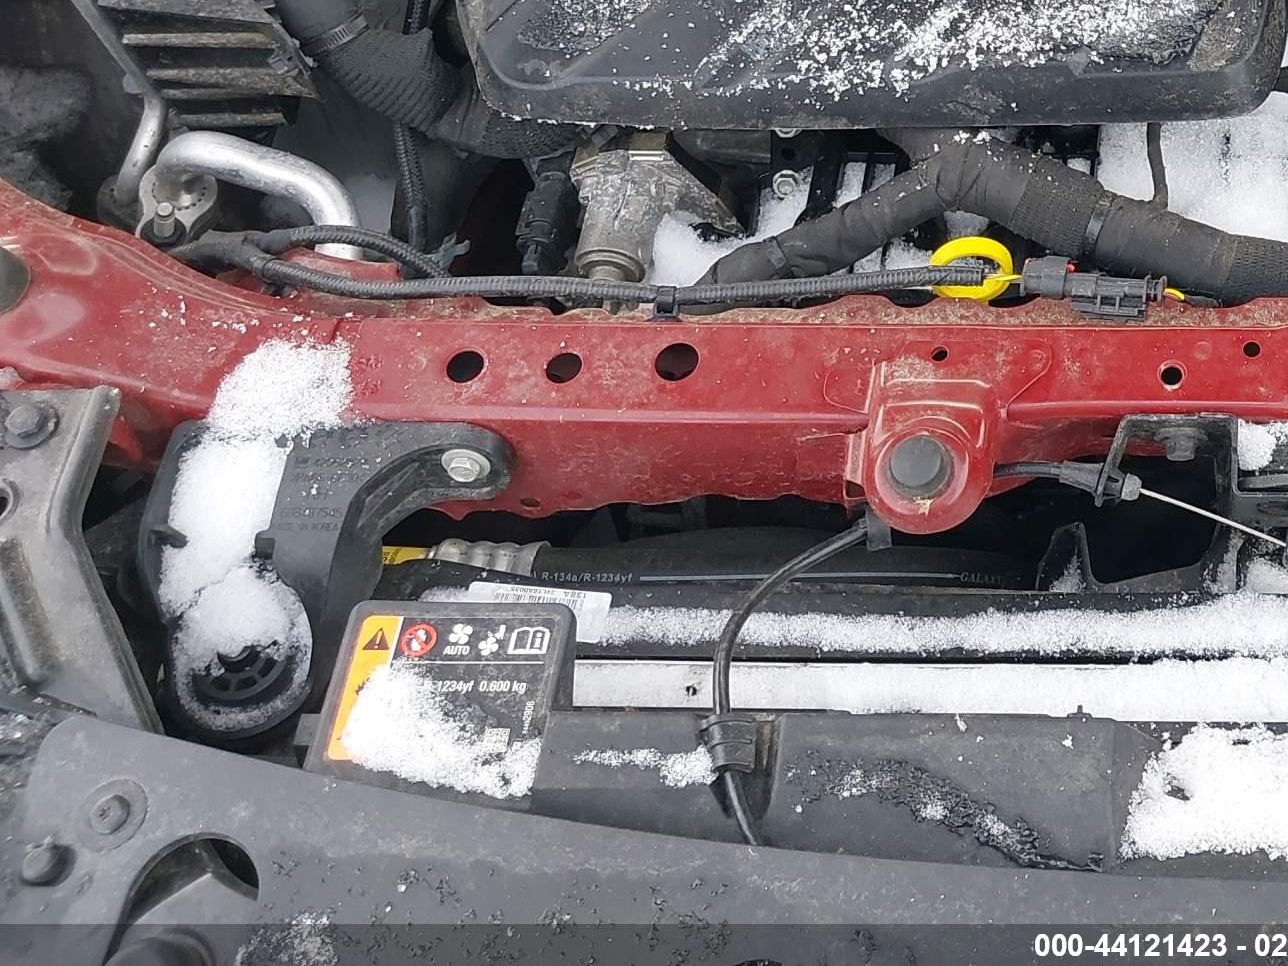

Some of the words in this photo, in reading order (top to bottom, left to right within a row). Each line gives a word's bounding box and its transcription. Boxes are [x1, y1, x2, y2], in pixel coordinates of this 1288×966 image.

[541, 571, 633, 584] R-134a/R-1234yf
[443, 645, 471, 656] AUTO
[479, 679, 511, 692] 0.600
[511, 679, 527, 695] kg
